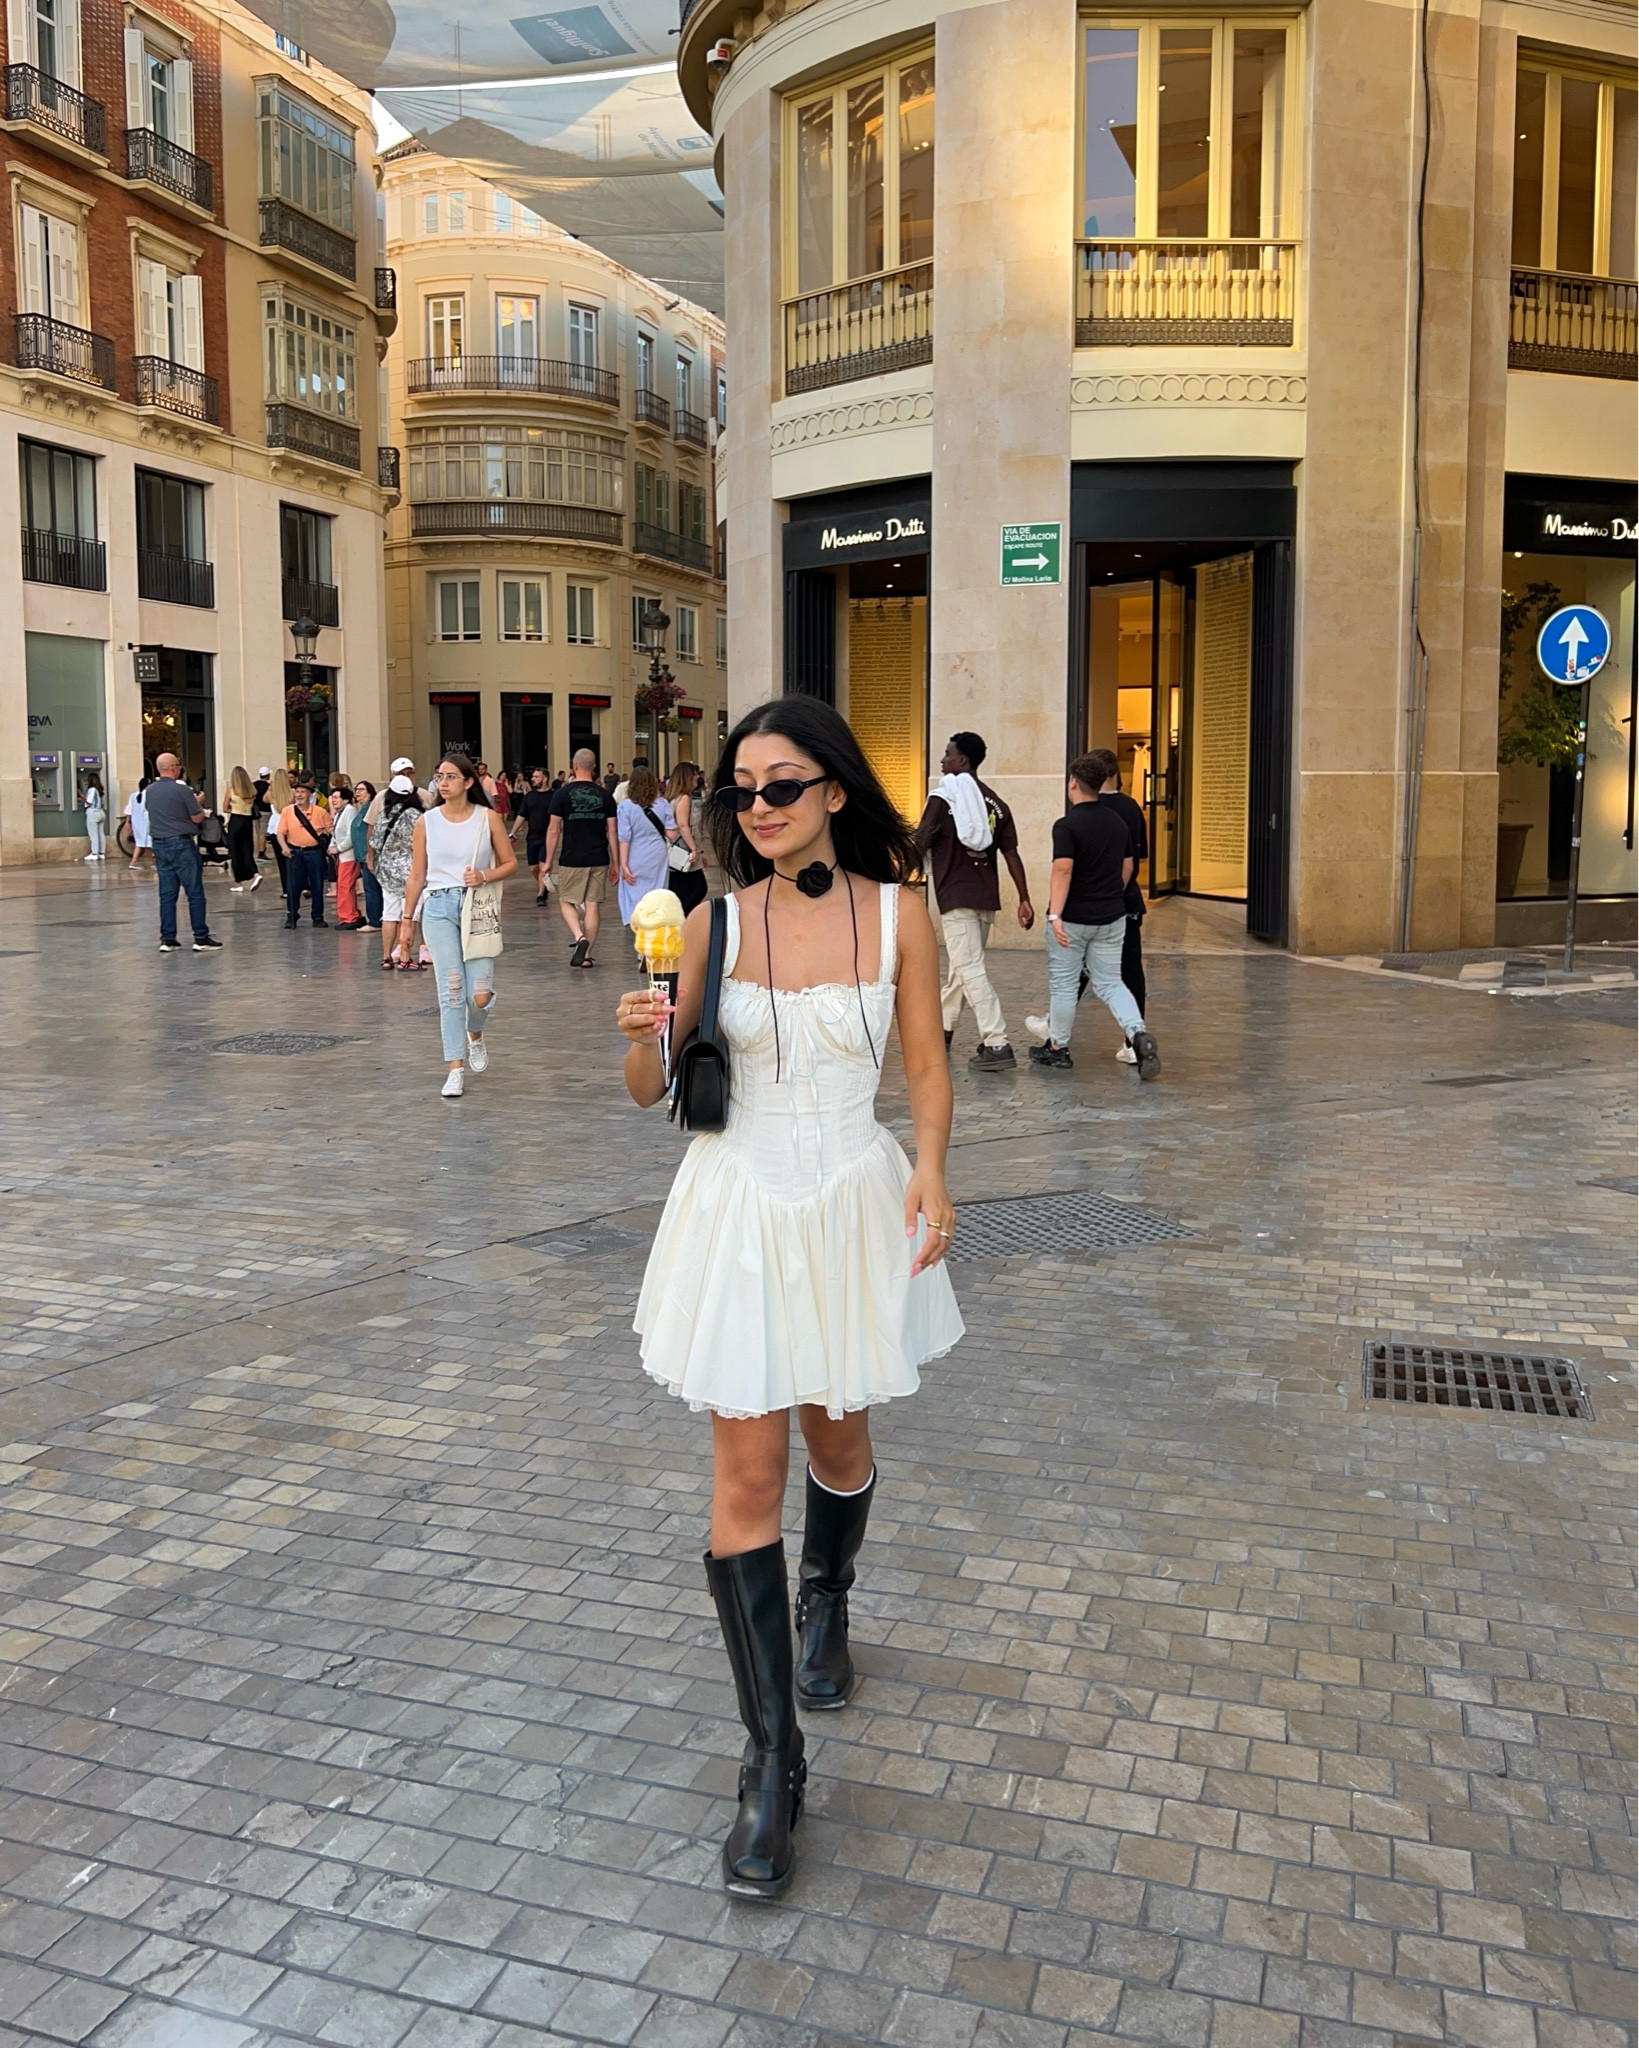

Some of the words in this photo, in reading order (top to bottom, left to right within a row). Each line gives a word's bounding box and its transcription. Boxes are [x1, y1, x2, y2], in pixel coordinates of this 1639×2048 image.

[1004, 527, 1018, 535] VIA
[1019, 526, 1031, 534] DE
[1544, 514, 1608, 537] Massimo
[820, 527, 883, 550] Massimo
[885, 517, 926, 541] Dutti
[1004, 533, 1057, 542] EVACUACION
[445, 741, 470, 751] Work
